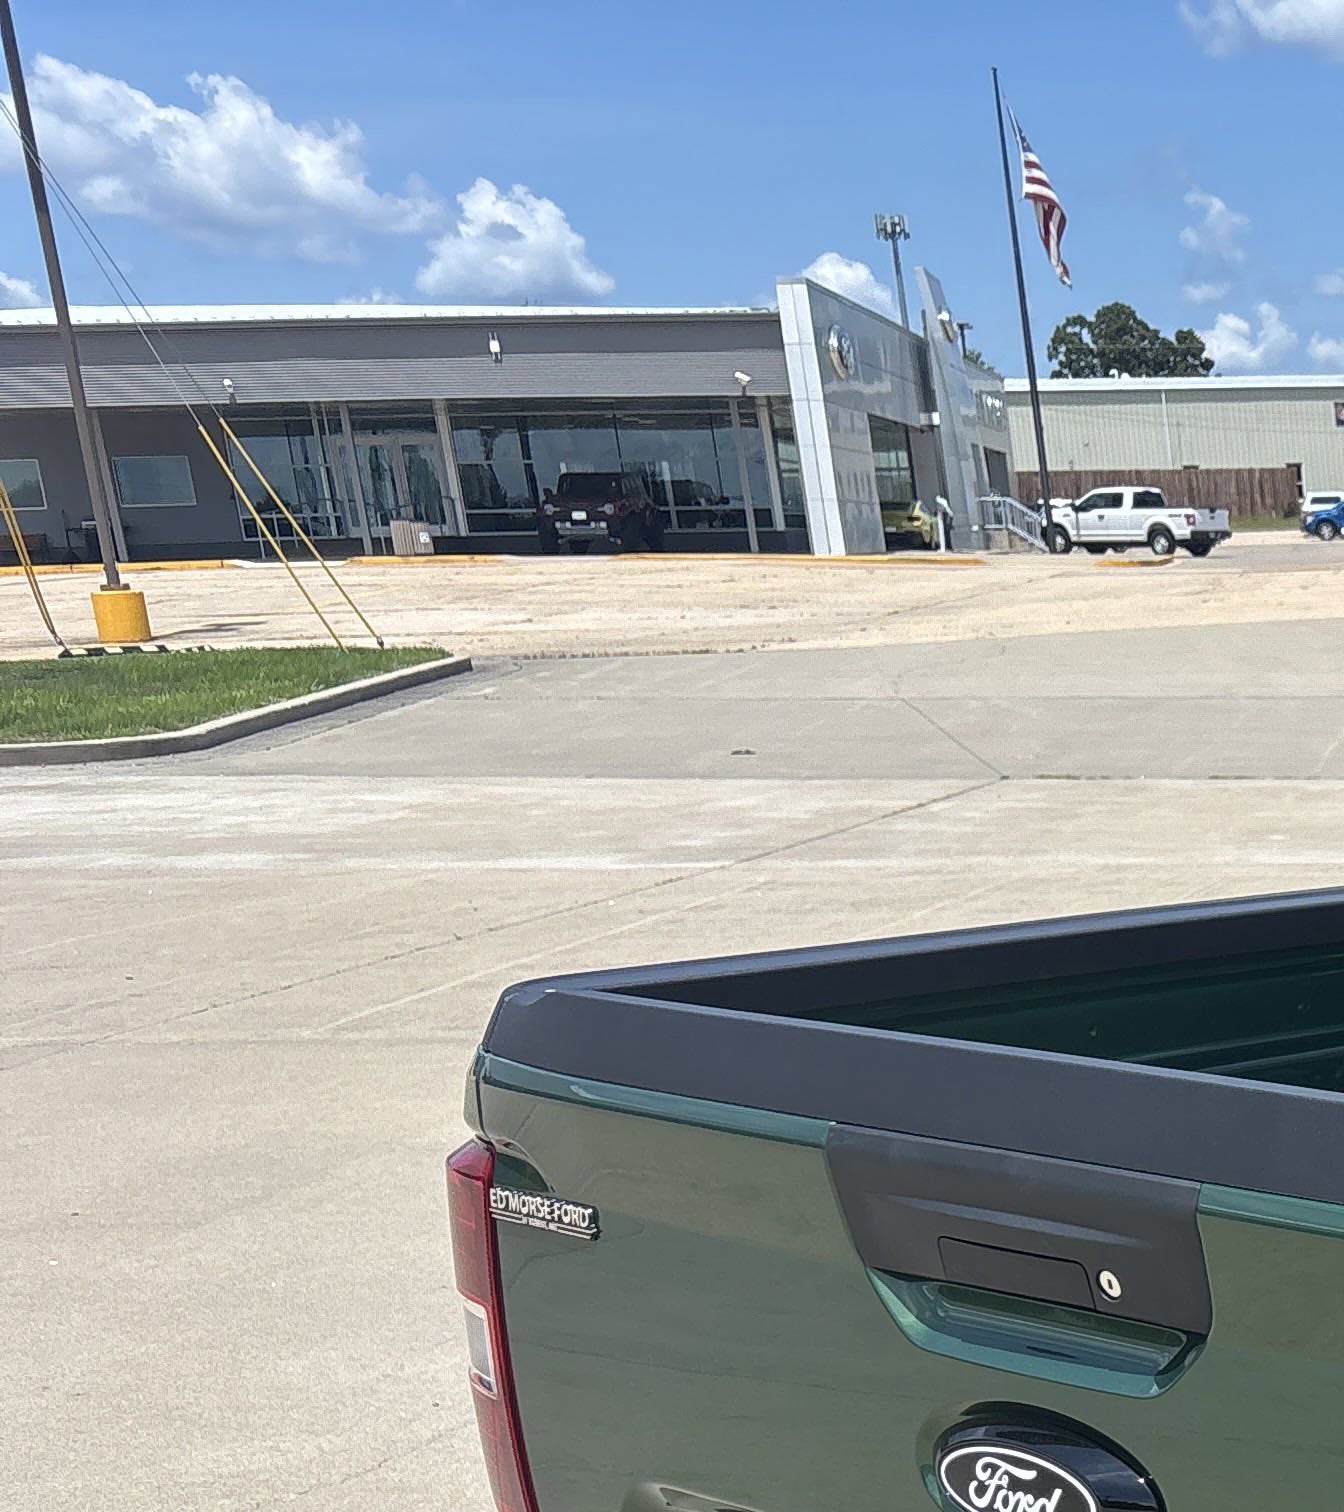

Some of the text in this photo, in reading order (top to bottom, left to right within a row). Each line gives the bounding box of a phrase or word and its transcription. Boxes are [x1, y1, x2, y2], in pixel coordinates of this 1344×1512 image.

[489, 1187, 507, 1209] ED
[508, 1191, 552, 1220] MORSE
[552, 1202, 591, 1228] FORD
